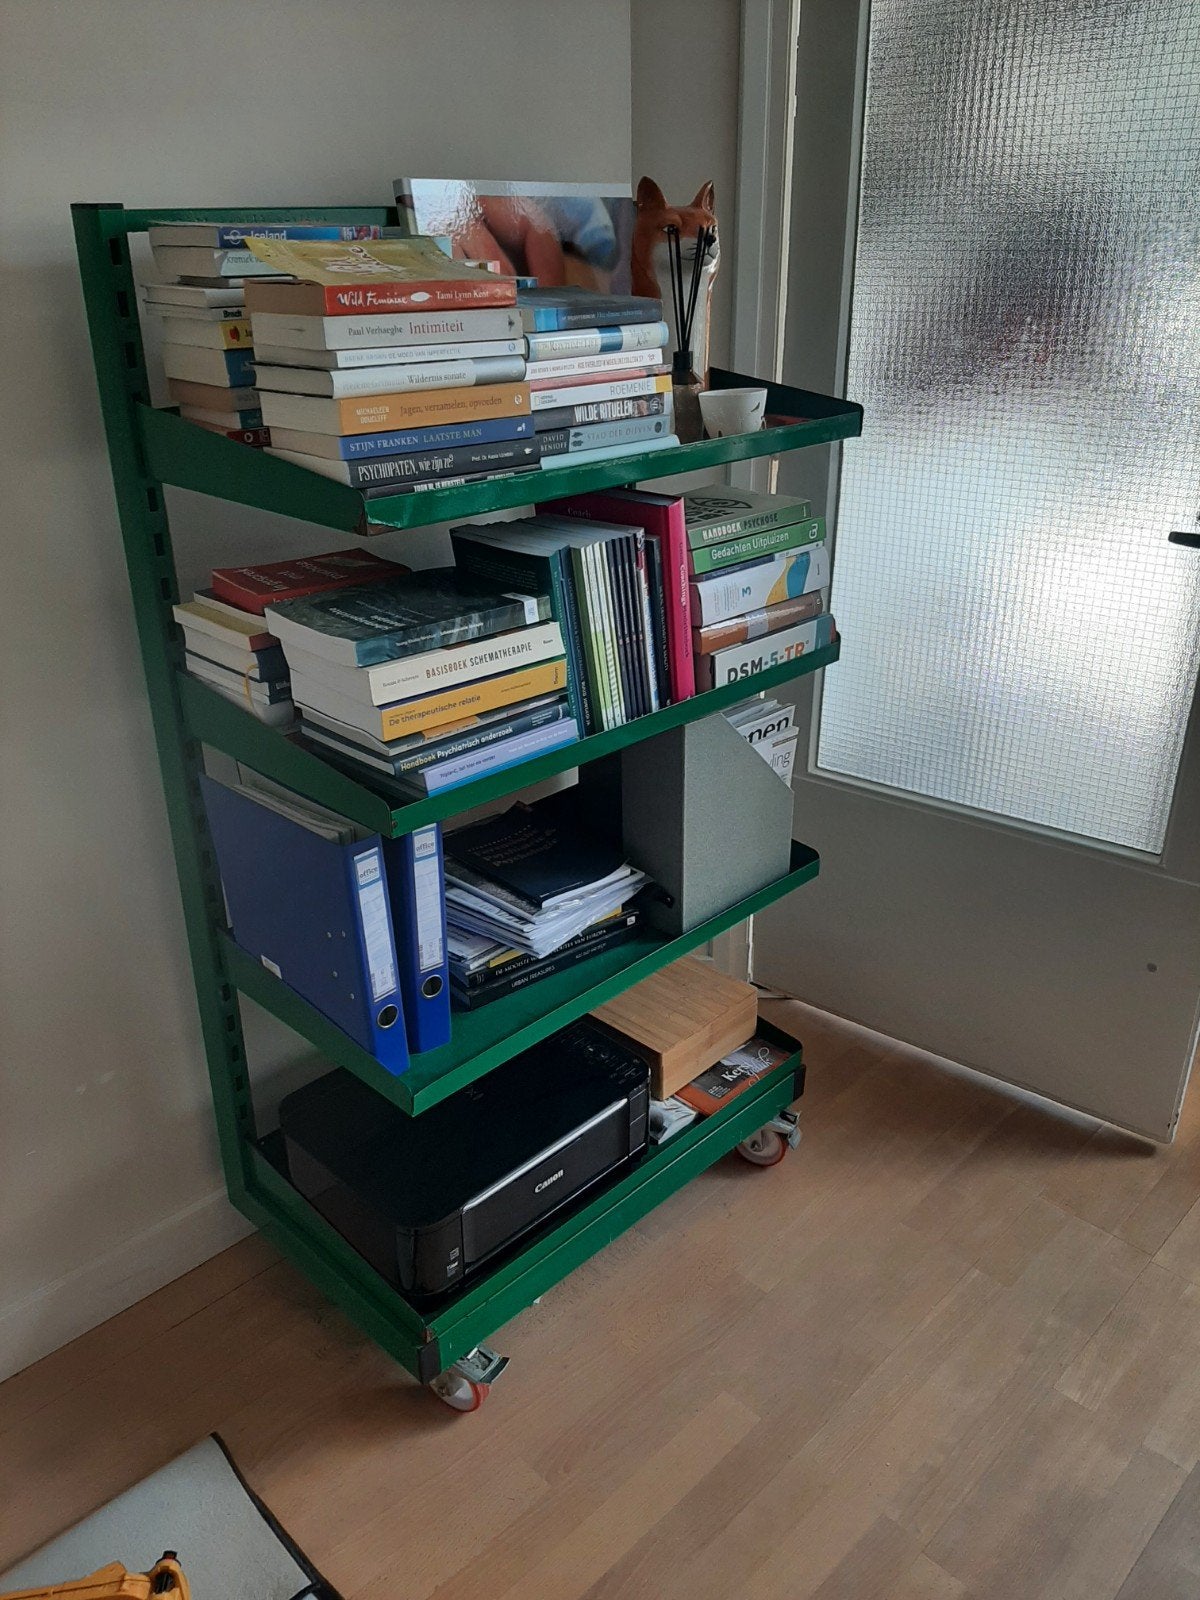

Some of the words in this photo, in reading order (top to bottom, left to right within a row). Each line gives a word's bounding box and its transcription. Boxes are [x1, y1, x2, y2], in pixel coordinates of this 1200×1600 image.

[251, 230, 287, 241] Iceland
[336, 290, 364, 308] Wild
[366, 289, 408, 307] Feminine
[436, 290, 453, 301] Tami
[454, 288, 472, 300] Lynn
[472, 287, 490, 299] Kent
[348, 326, 365, 337] Paul
[366, 324, 404, 337] Verhaeghe
[409, 320, 465, 335] Intimiteit
[400, 404, 423, 417] Jagen,
[424, 400, 469, 413] verzamelen,
[469, 396, 503, 410] opvoeden
[574, 403, 598, 423] WILDE
[600, 399, 633, 419] RITUELEN
[349, 442, 375, 452] STIJN
[377, 435, 420, 447] FRANKEN
[423, 430, 461, 444] LAATSTE
[463, 428, 483, 439] MAN
[543, 433, 564, 444] DAVID
[588, 430, 607, 442] STAD
[358, 458, 419, 482] PSYCHOPATEN,
[418, 457, 431, 472] wie
[432, 456, 443, 473] zijn
[702, 521, 742, 542] HANDBOEK
[743, 512, 779, 529] PSYCHOSE
[711, 542, 752, 561] Gedachten
[752, 532, 790, 551] Uitpluizen
[425, 657, 469, 680] BASISBOEK
[469, 640, 533, 667] SCHEMATHERAPIE
[389, 717, 400, 727] De
[400, 700, 458, 724] therapeutische
[458, 693, 482, 708] relatie
[744, 716, 791, 744] nen
[400, 754, 436, 773] Handboek
[436, 737, 481, 759] Psychiatrisch
[480, 725, 514, 744] onderzoek
[416, 841, 435, 853] office
[359, 865, 379, 879] office
[511, 975, 529, 988] URBAN
[529, 965, 556, 981] TREASURES
[534, 1168, 564, 1194] Canon
